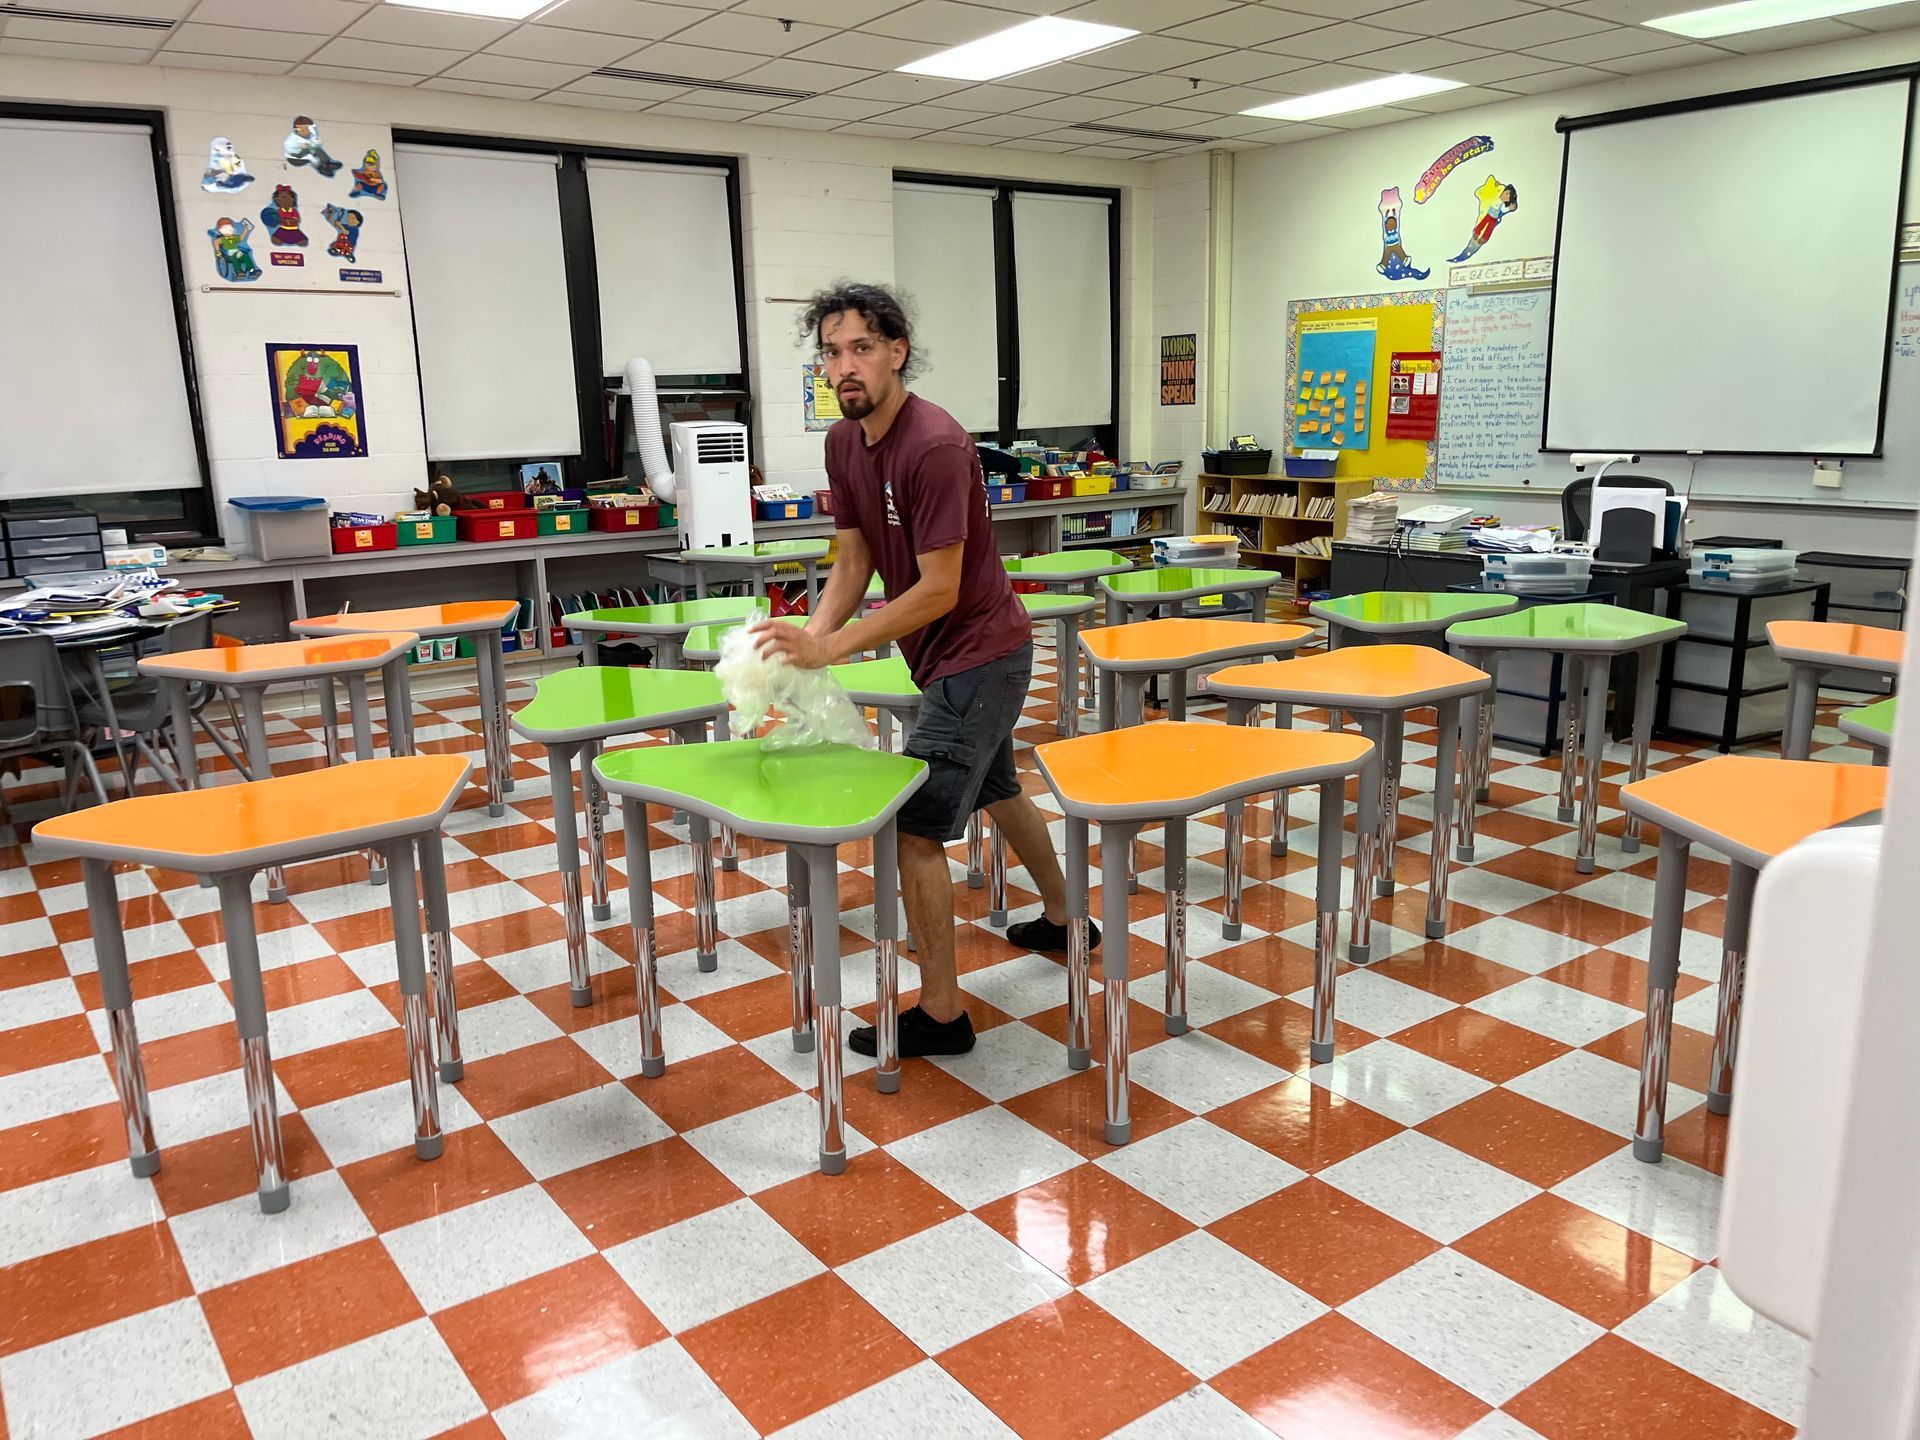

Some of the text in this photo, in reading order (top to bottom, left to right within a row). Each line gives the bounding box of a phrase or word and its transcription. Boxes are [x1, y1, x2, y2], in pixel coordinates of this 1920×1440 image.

[1423, 138, 1478, 186] Everyone
[1427, 176, 1441, 195] can
[1441, 164, 1453, 175] be
[1463, 142, 1489, 159] star!
[1162, 336, 1195, 357] WORDS
[1518, 353, 1525, 361] to
[1162, 360, 1195, 381] THINK
[1467, 363, 1474, 373] by
[1470, 378, 1494, 386] engage
[313, 432, 347, 445] READING
